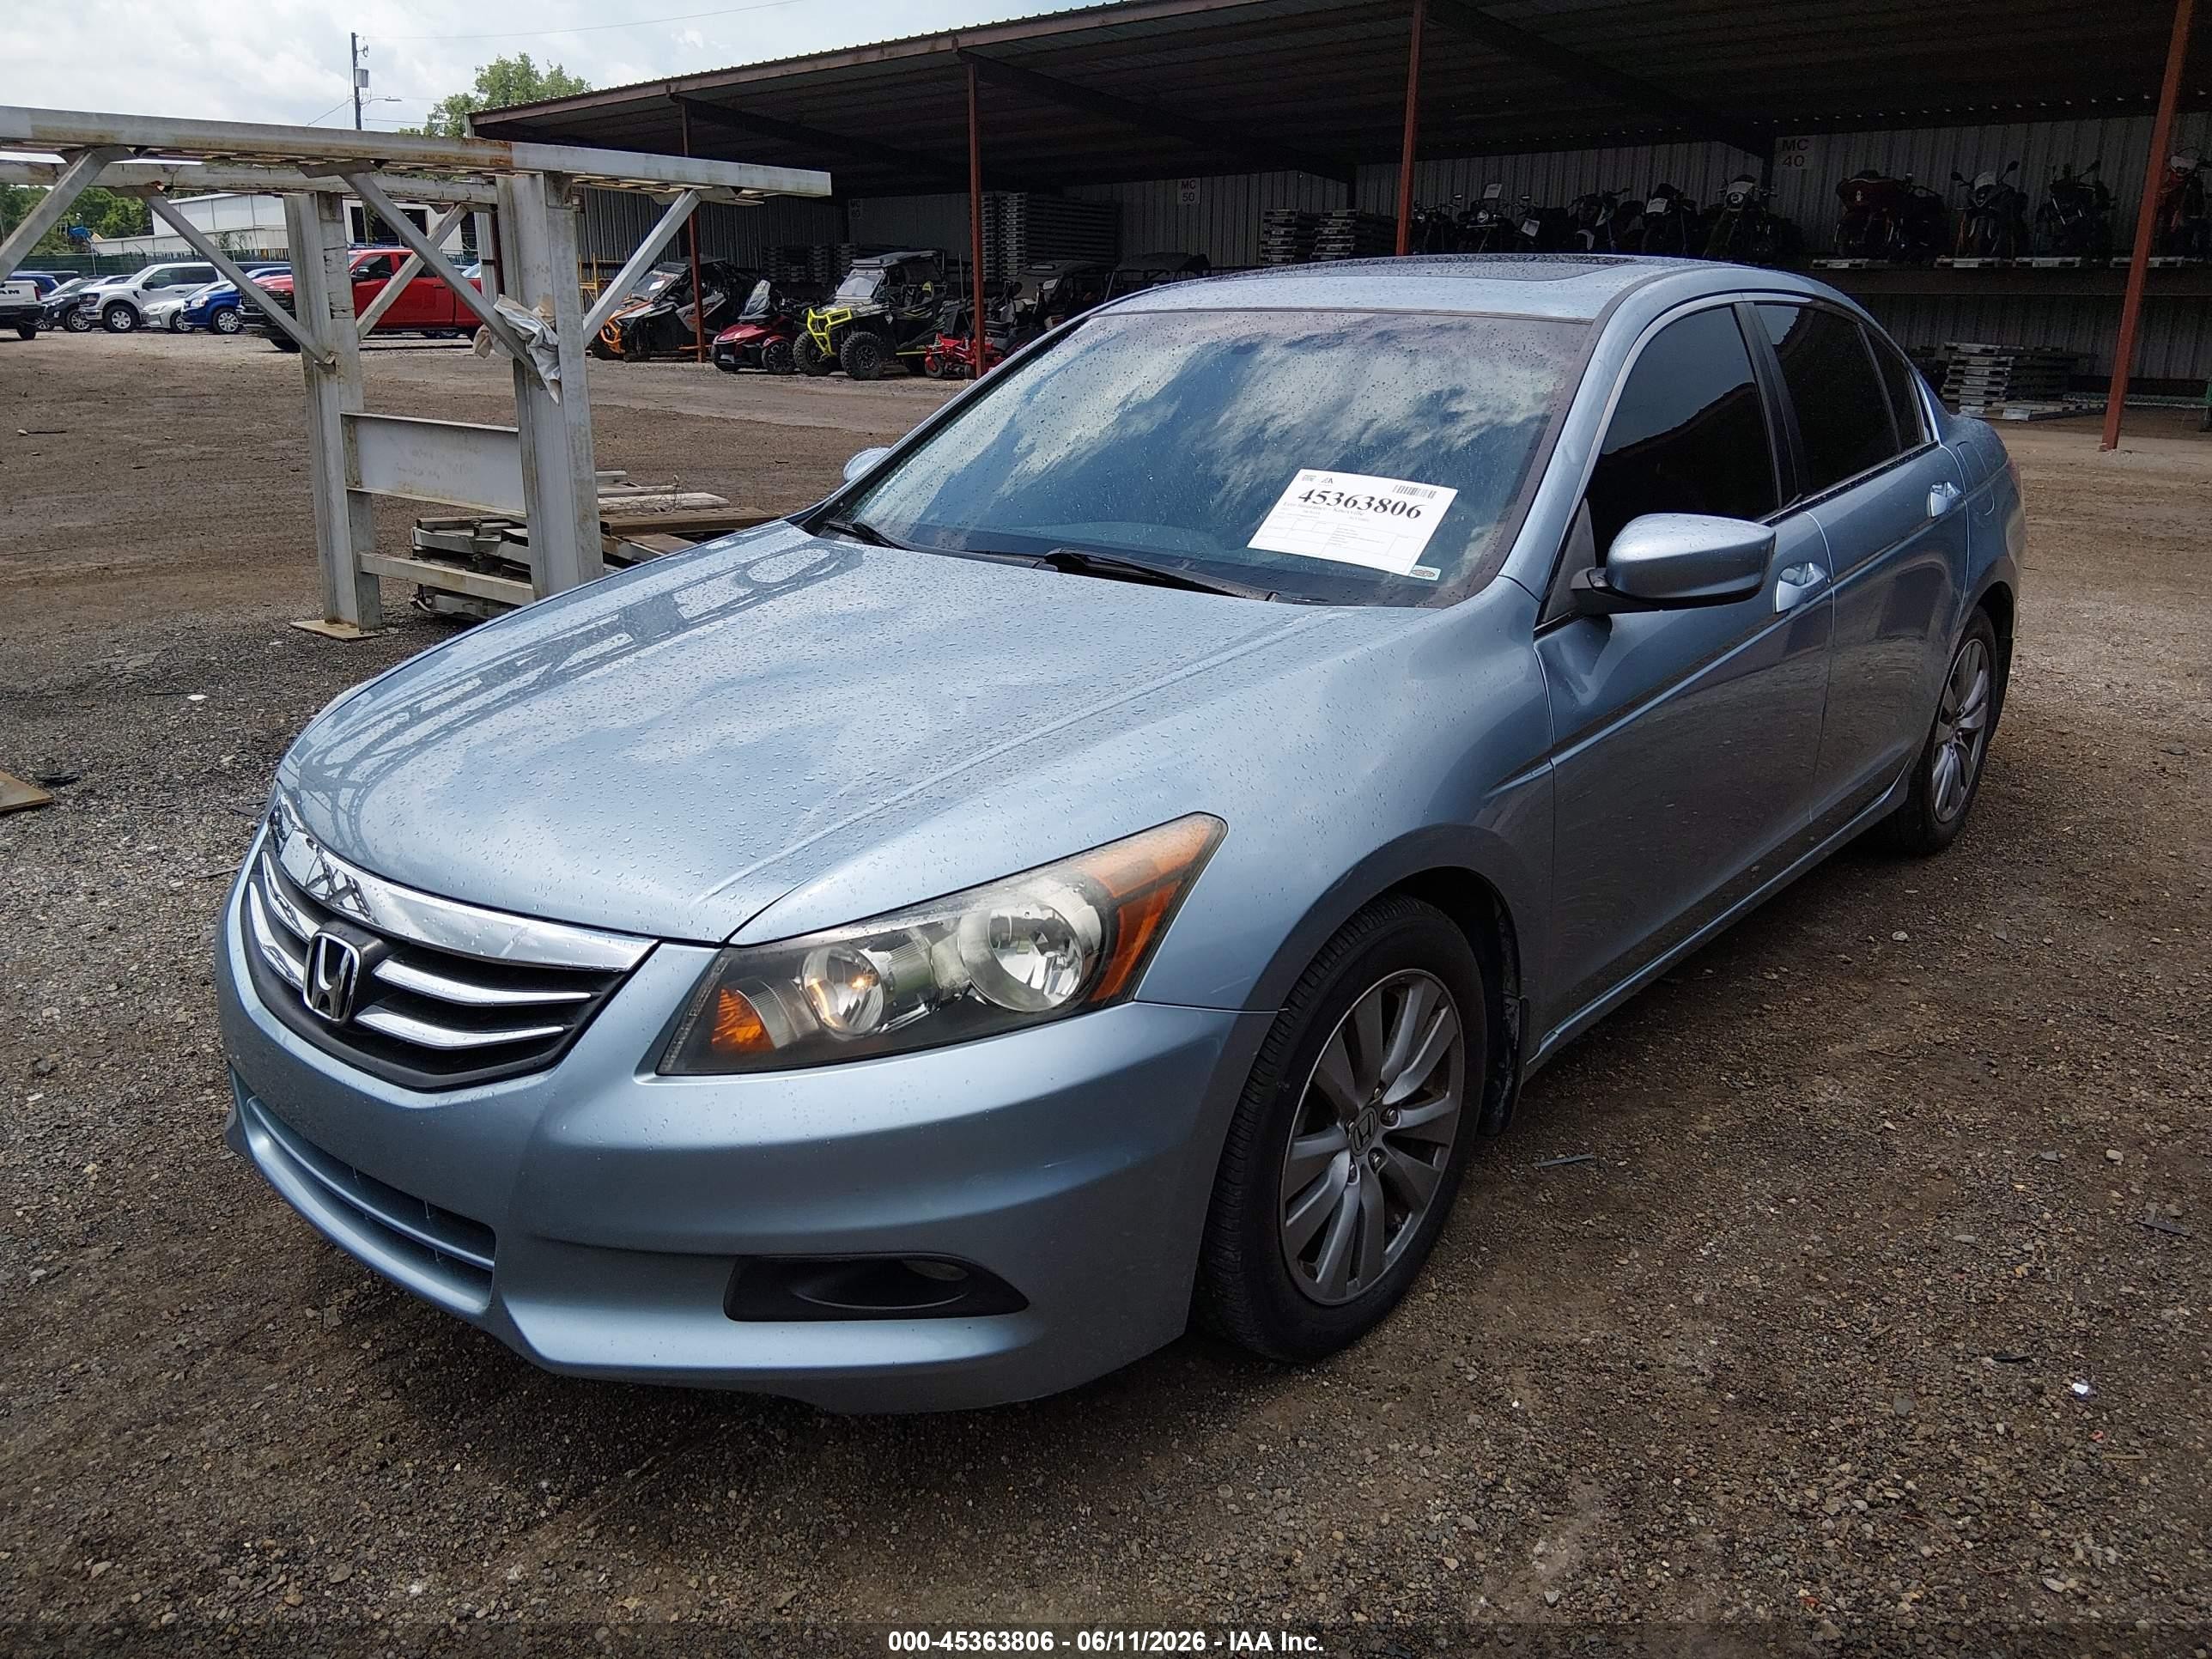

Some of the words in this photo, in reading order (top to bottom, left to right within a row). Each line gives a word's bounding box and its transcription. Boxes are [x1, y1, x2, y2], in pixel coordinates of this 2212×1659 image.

[1783, 138, 1808, 151] MC
[1782, 155, 1805, 167] 40
[1182, 179, 1195, 190] MC
[1182, 192, 1194, 202] 50
[1298, 489, 1429, 519] 45363806
